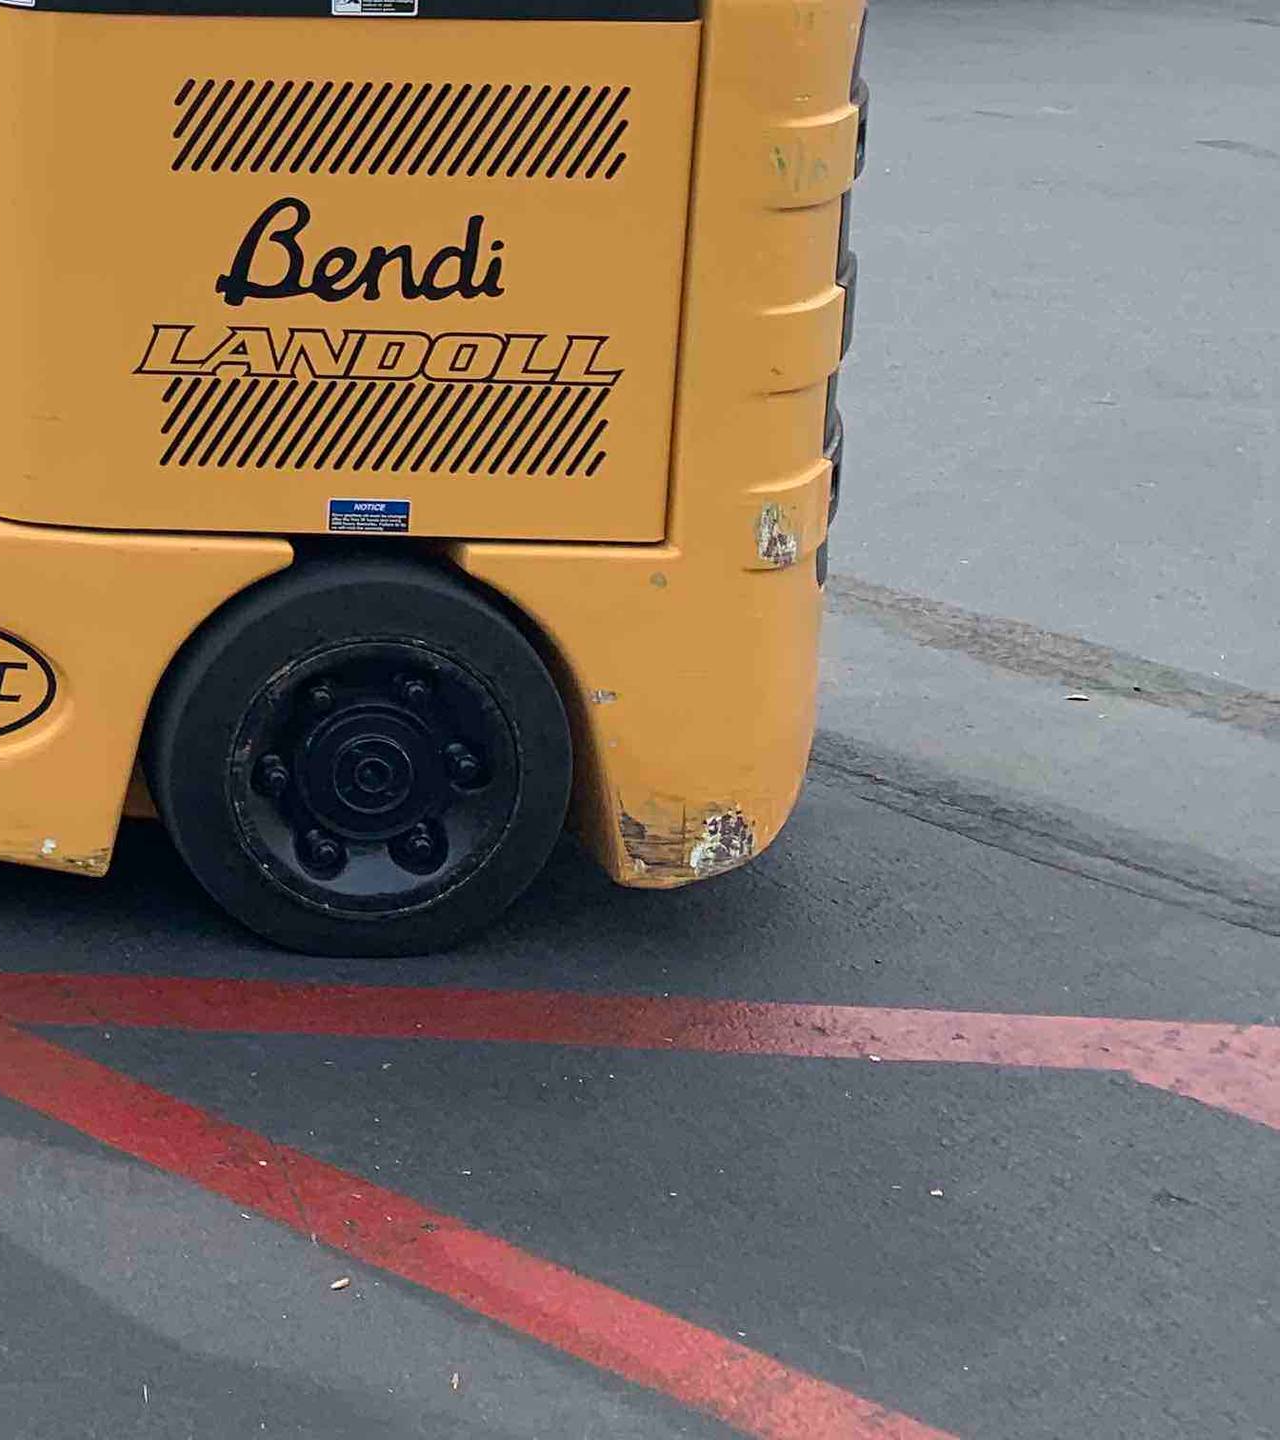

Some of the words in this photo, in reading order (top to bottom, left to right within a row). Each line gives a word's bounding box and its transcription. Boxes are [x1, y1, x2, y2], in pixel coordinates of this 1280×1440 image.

[215, 197, 505, 306] Bendi
[133, 323, 625, 387] LANDOLL
[353, 503, 386, 511] NOTICE
